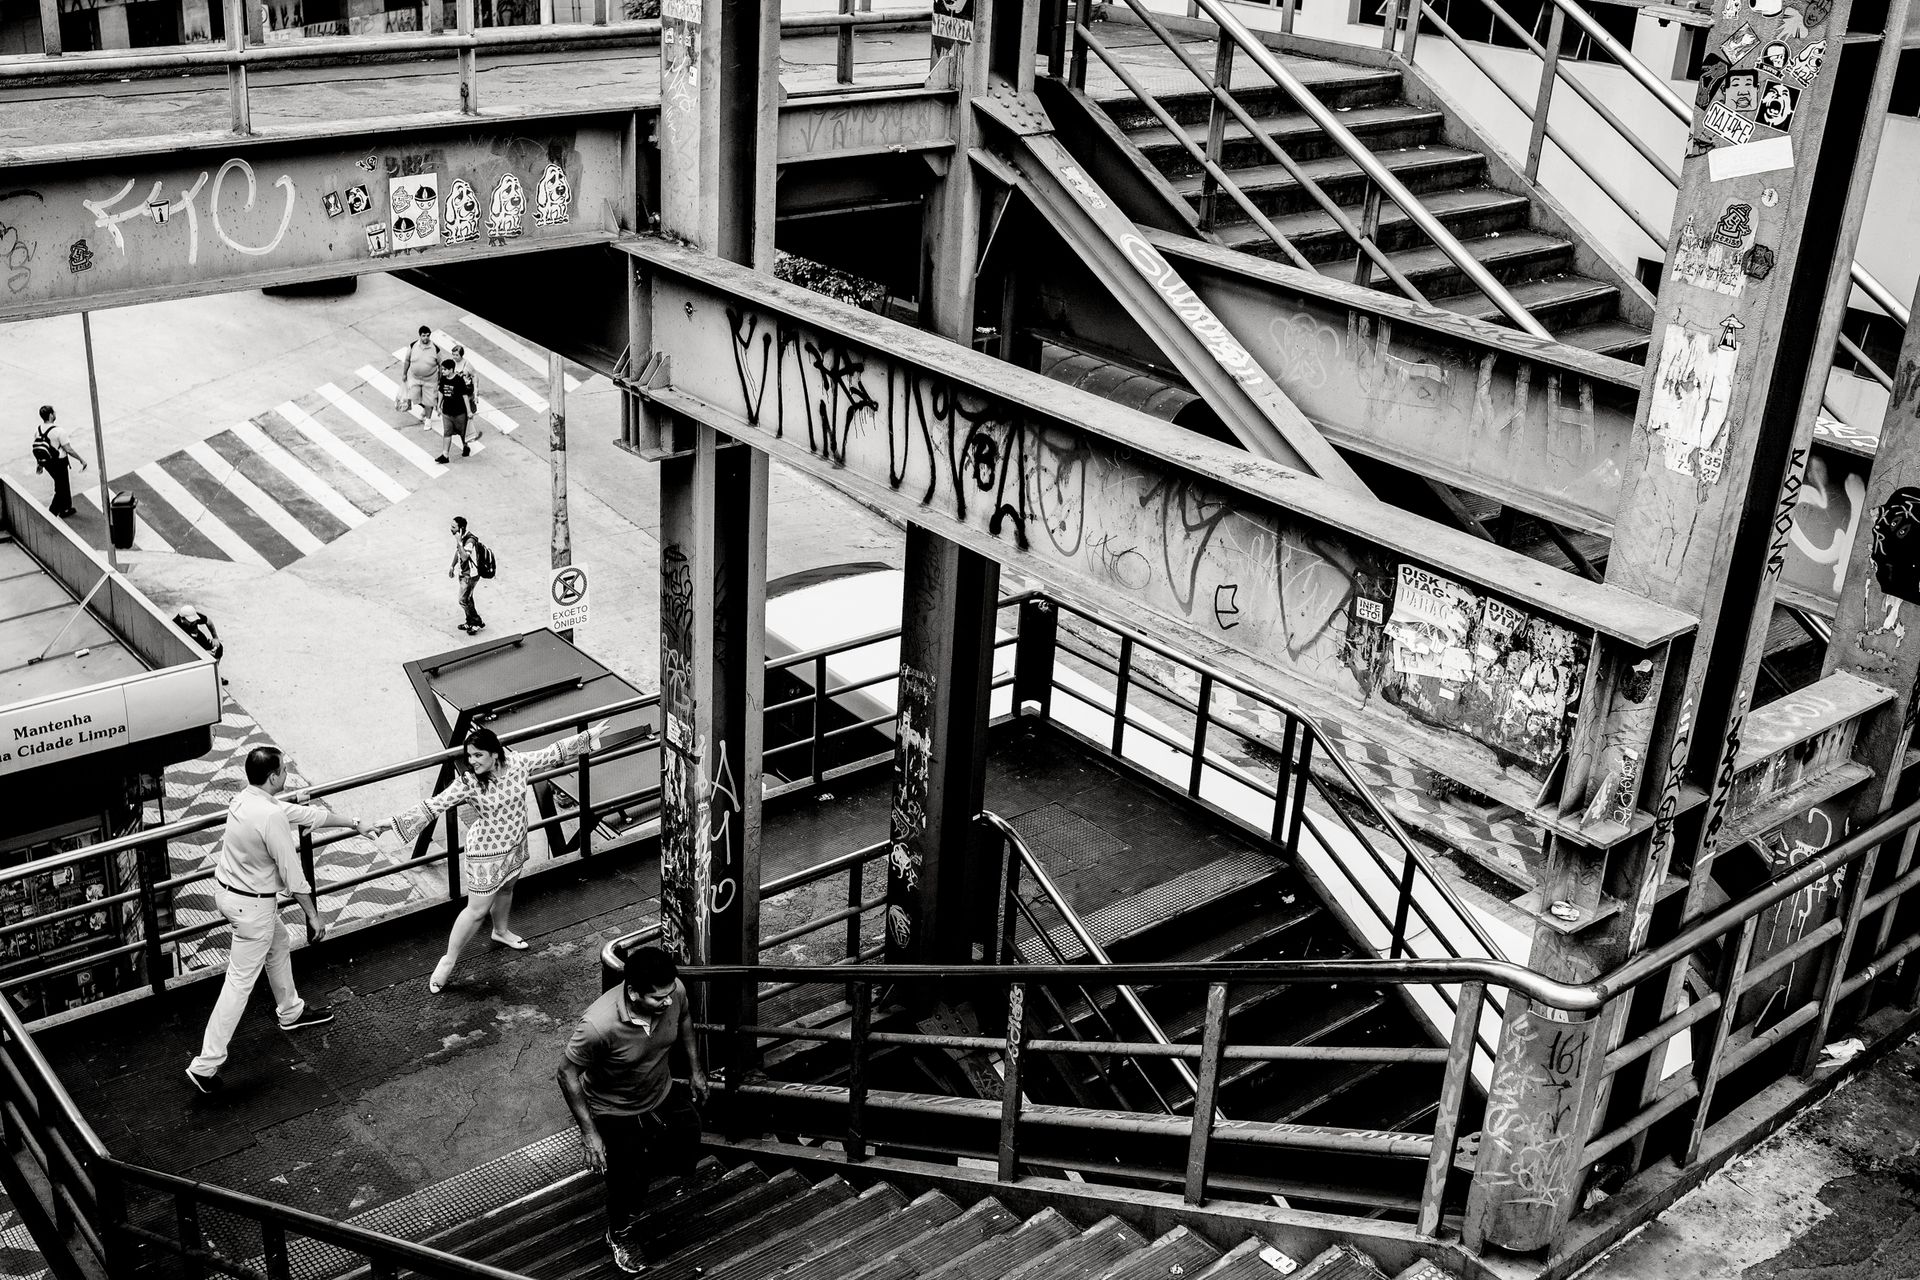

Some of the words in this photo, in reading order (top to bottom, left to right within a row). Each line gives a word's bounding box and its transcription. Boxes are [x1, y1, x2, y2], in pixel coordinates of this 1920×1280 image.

[1402, 566, 1439, 588] DISK
[1403, 575, 1451, 599] VIAG
[552, 604, 588, 620] EXCETO
[554, 614, 588, 630] ÔNIBUS
[13, 713, 92, 740] Mantenha
[0, 752, 12, 763] a
[17, 736, 74, 757] Cidade
[78, 724, 127, 744] Limpa
